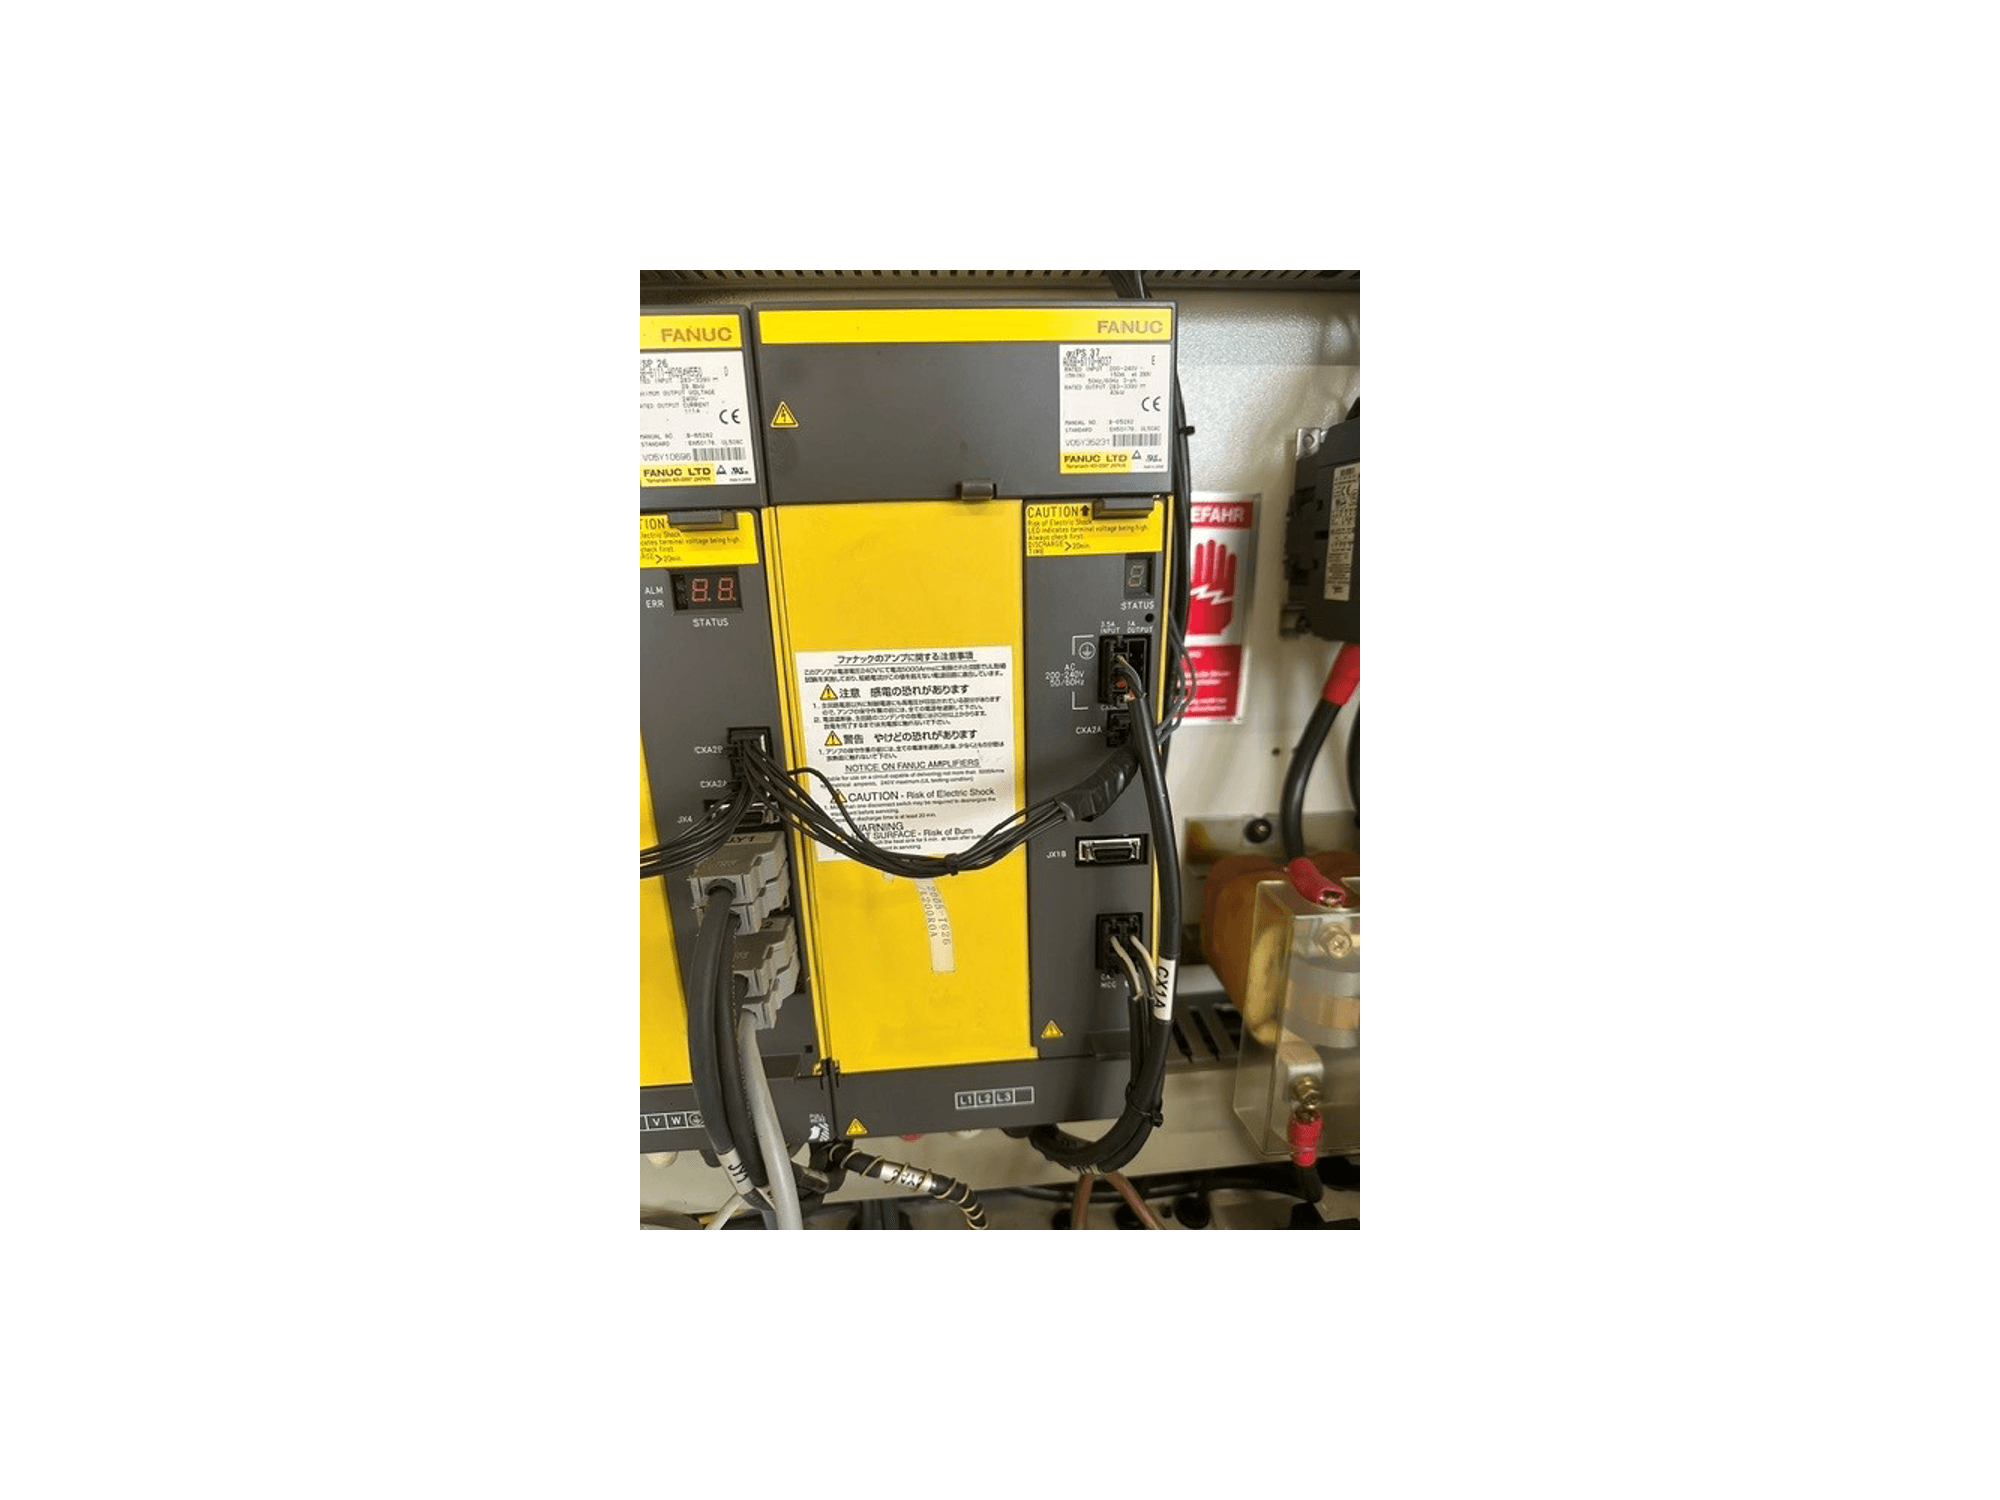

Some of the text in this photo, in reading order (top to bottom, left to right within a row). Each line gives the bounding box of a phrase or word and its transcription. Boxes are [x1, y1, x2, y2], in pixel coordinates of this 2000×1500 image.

[1097, 319, 1163, 334] FANUC
[660, 326, 732, 342] FANUC
[1064, 454, 1128, 463] FANUC LTD
[643, 467, 711, 477] FANUC LTD
[1027, 506, 1079, 518] CAUTION
[644, 586, 664, 595] ALM
[645, 599, 665, 608] ERR
[1120, 600, 1154, 611] STATUS
[692, 617, 730, 628] STATUS
[1127, 626, 1154, 634] OUTPUT
[1064, 663, 1076, 671] AC
[1045, 671, 1085, 680] 200-240V
[1050, 679, 1085, 687] 50/60Hz
[839, 684, 970, 699] 注意 感電の恐れがあります
[1075, 726, 1103, 735] CXA2A
[843, 729, 978, 745] 警告 やけどの恐れがあります
[845, 759, 980, 772] NOTICE ON FANUC AMPLIFIERS
[848, 787, 995, 802] CAUTION Risk of Electric Shock
[677, 815, 693, 824] JX4
[873, 829, 917, 840] SURFACE
[923, 829, 943, 837] Risk
[944, 828, 953, 836] of
[954, 827, 974, 835] Burn
[1046, 850, 1067, 859] JX1B
[1154, 966, 1170, 1009] CX1A
[959, 1091, 1012, 1106] L1 L2 L3
[652, 1116, 682, 1126] V W
